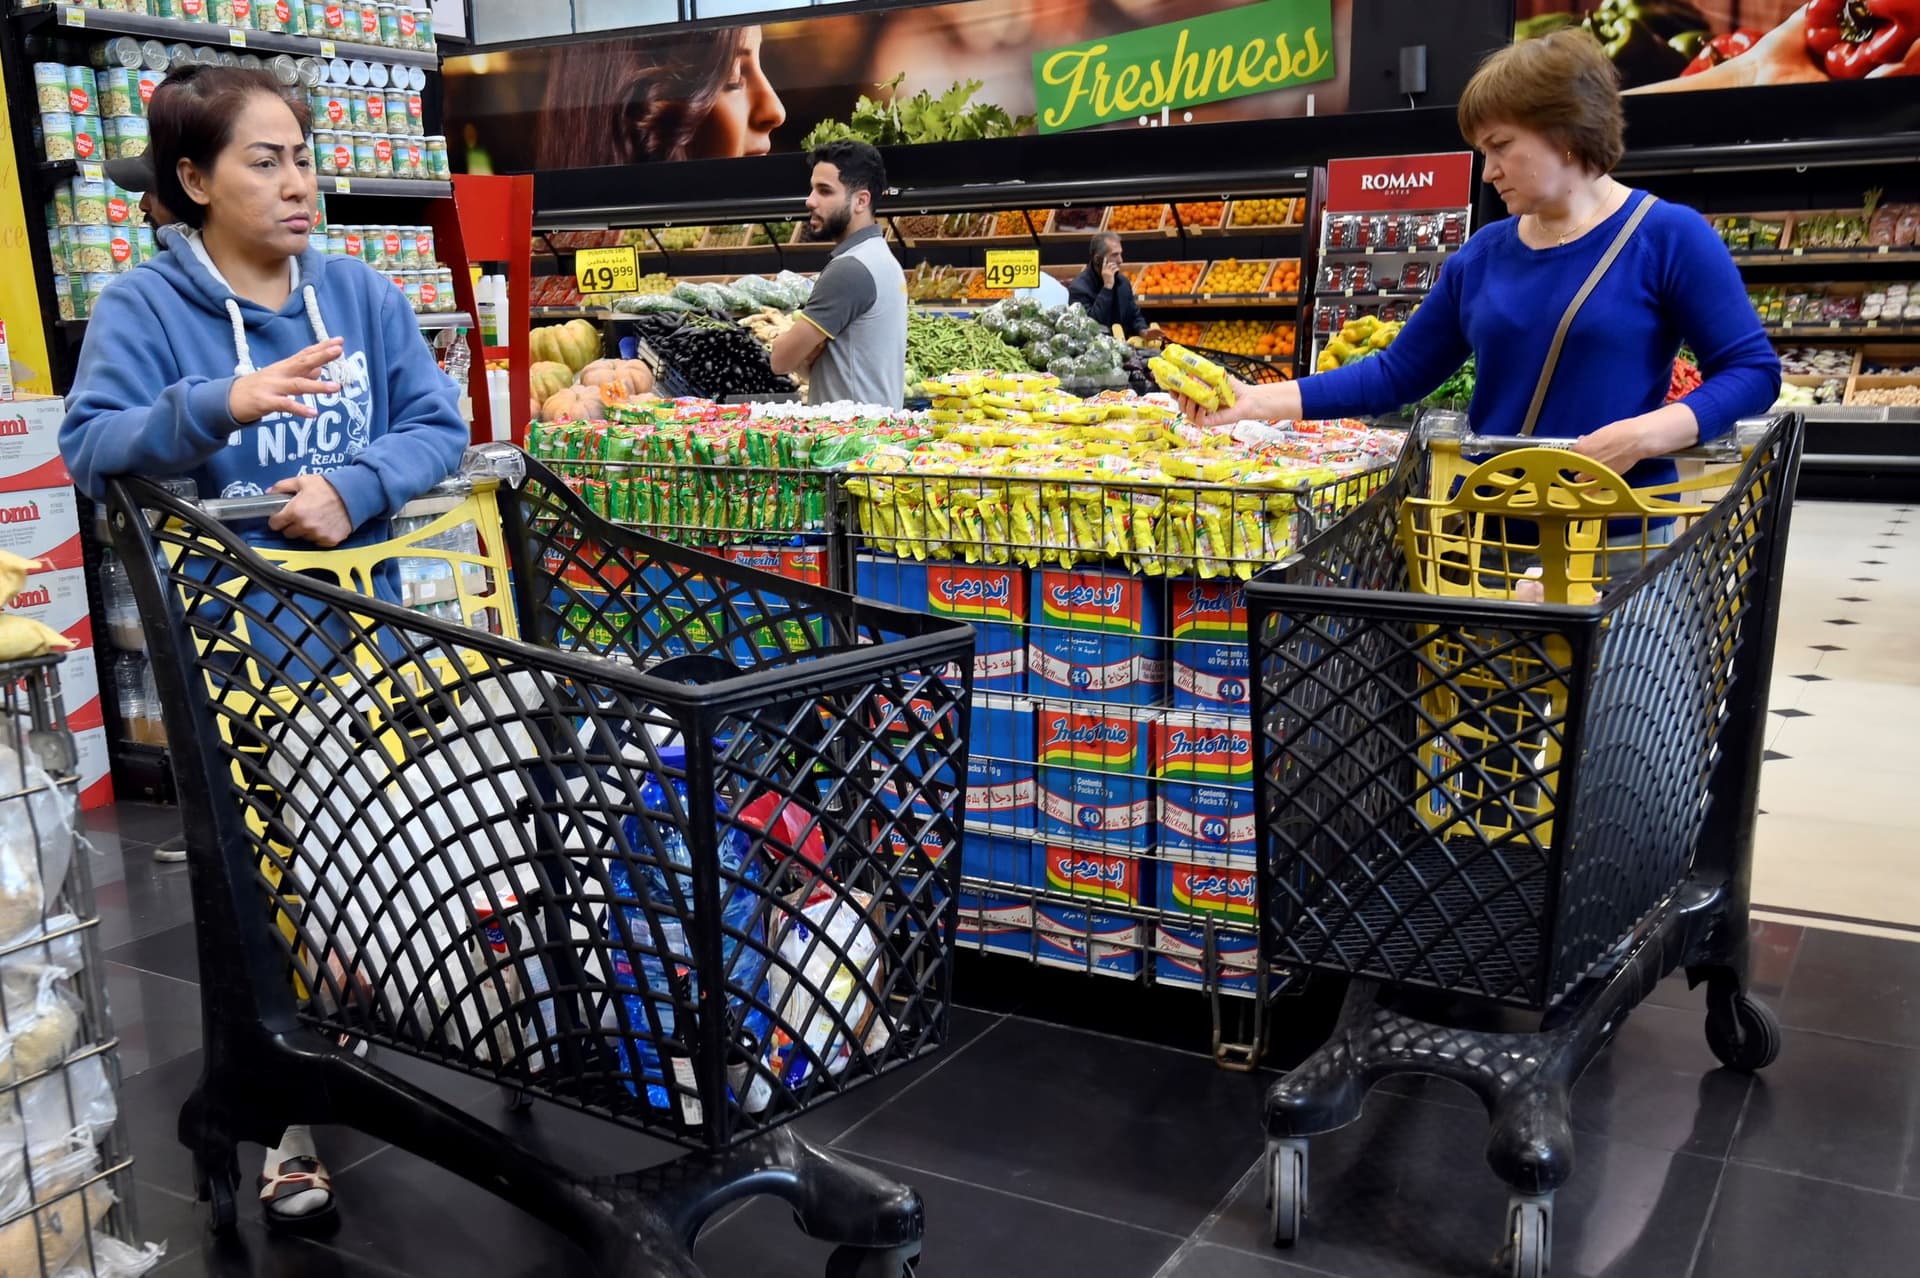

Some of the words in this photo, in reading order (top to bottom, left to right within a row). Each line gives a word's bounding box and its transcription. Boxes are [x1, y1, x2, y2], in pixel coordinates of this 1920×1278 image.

[1042, 27, 1329, 127] Freshness
[1361, 171, 1434, 190] ROMAN
[1217, 657, 1234, 666] Pacs
[1221, 683, 1242, 696] 40
[1204, 823, 1225, 836] 40
